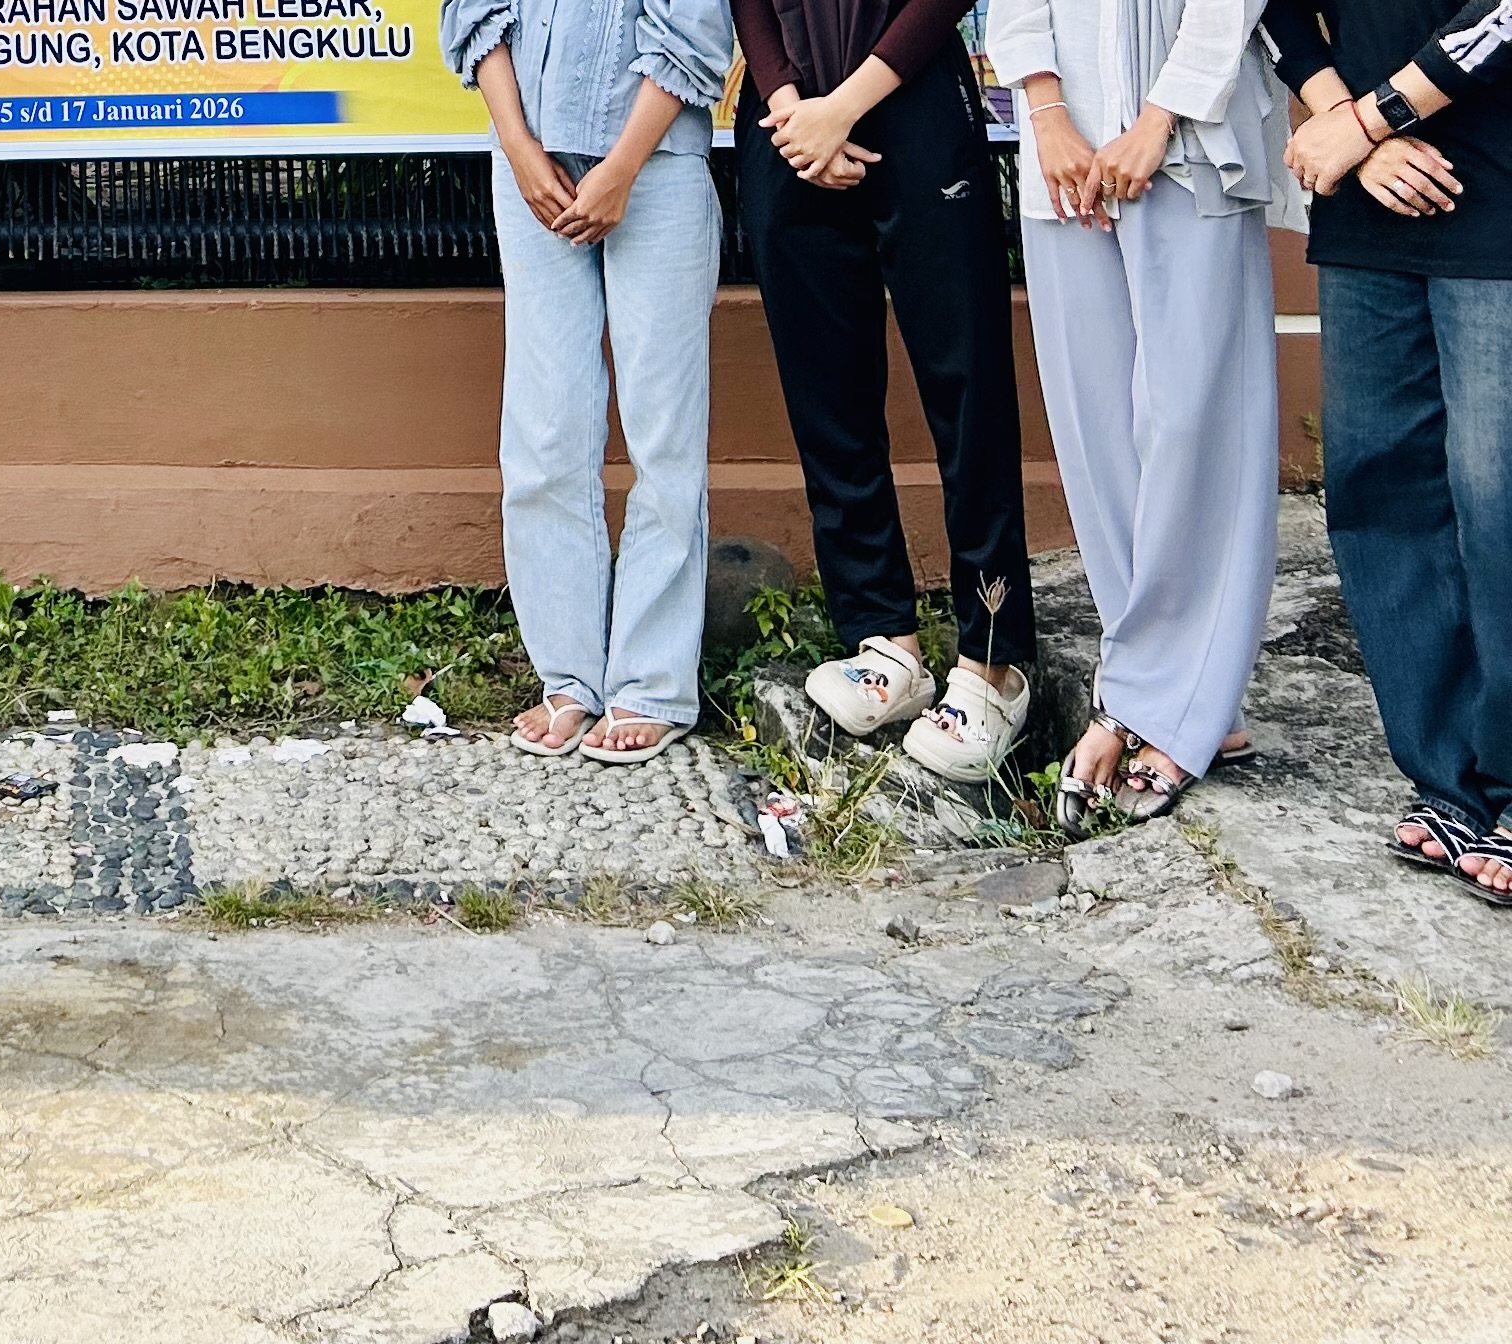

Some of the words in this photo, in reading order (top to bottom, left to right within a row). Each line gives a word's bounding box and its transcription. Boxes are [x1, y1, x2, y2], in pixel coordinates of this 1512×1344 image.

[113, 30, 205, 63] KOTA
[215, 27, 411, 60] BENGKULU
[20, 101, 52, 122] s/d
[61, 100, 85, 121] 17
[92, 99, 183, 121] Januari
[189, 98, 244, 119] 2026
